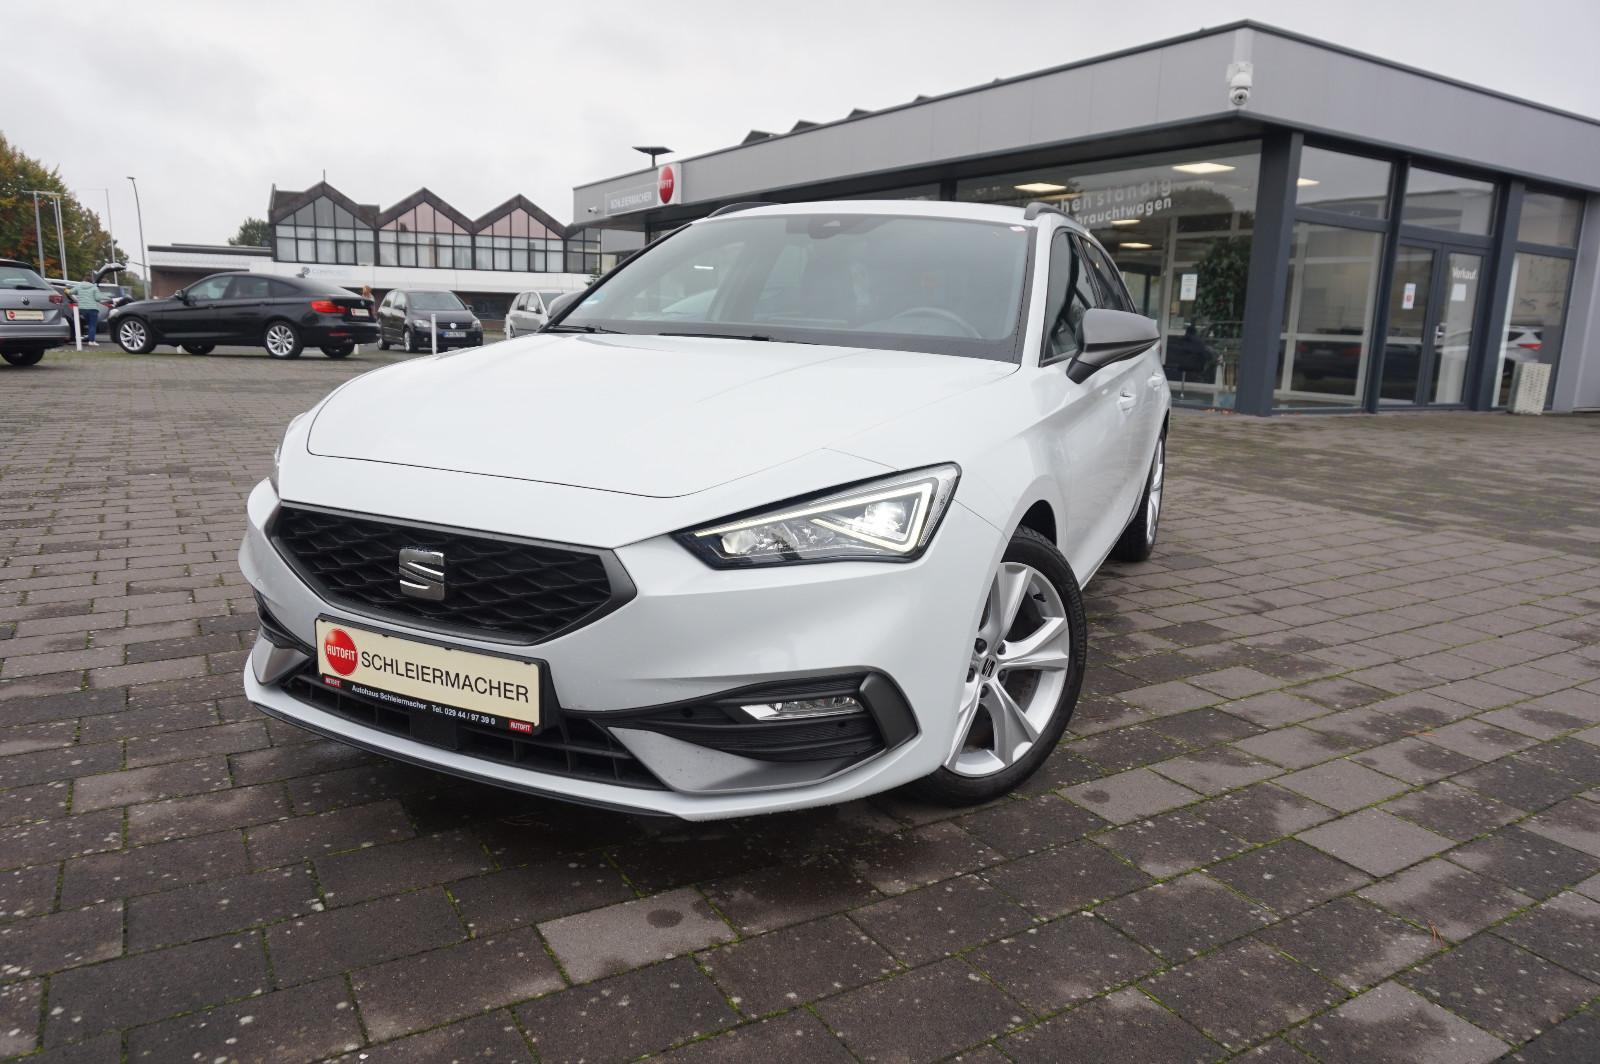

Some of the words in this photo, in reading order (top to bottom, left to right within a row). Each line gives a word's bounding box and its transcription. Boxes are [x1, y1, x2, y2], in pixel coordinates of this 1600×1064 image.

[326, 644, 355, 662] AUTOFIT
[361, 651, 529, 703] SCHLEIERMACHER
[351, 685, 379, 698] Autohaus
[380, 692, 427, 710] Schleiermacher
[432, 704, 444, 714] Tel.
[444, 708, 456, 718] 029
[457, 711, 466, 719] 44
[470, 713, 479, 722] 97
[510, 721, 531, 732] AUTOFIT
